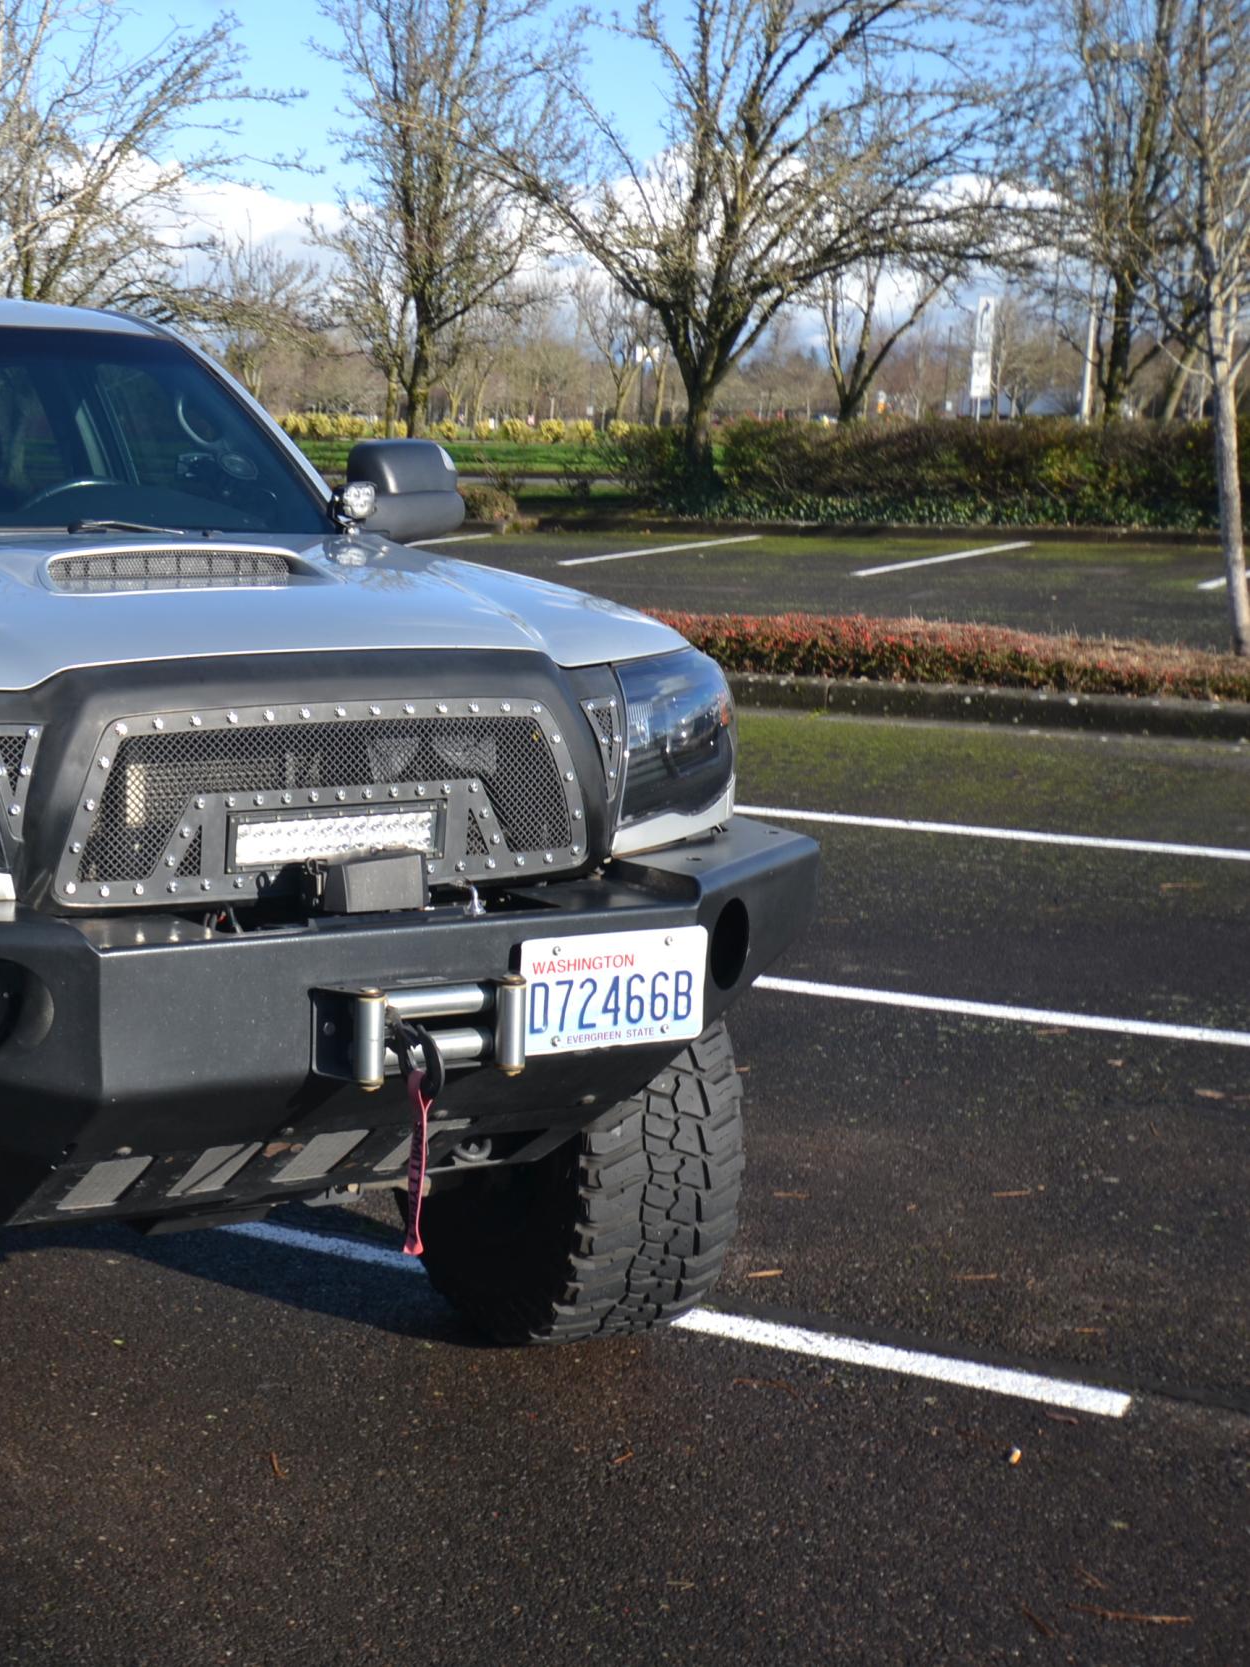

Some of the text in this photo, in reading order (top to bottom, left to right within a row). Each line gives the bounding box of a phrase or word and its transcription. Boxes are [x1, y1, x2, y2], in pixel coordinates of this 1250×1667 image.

[532, 954, 635, 975] WASHINGTON
[529, 970, 693, 1034] D72466B
[566, 1027, 655, 1044] EVERGREEN STATE
